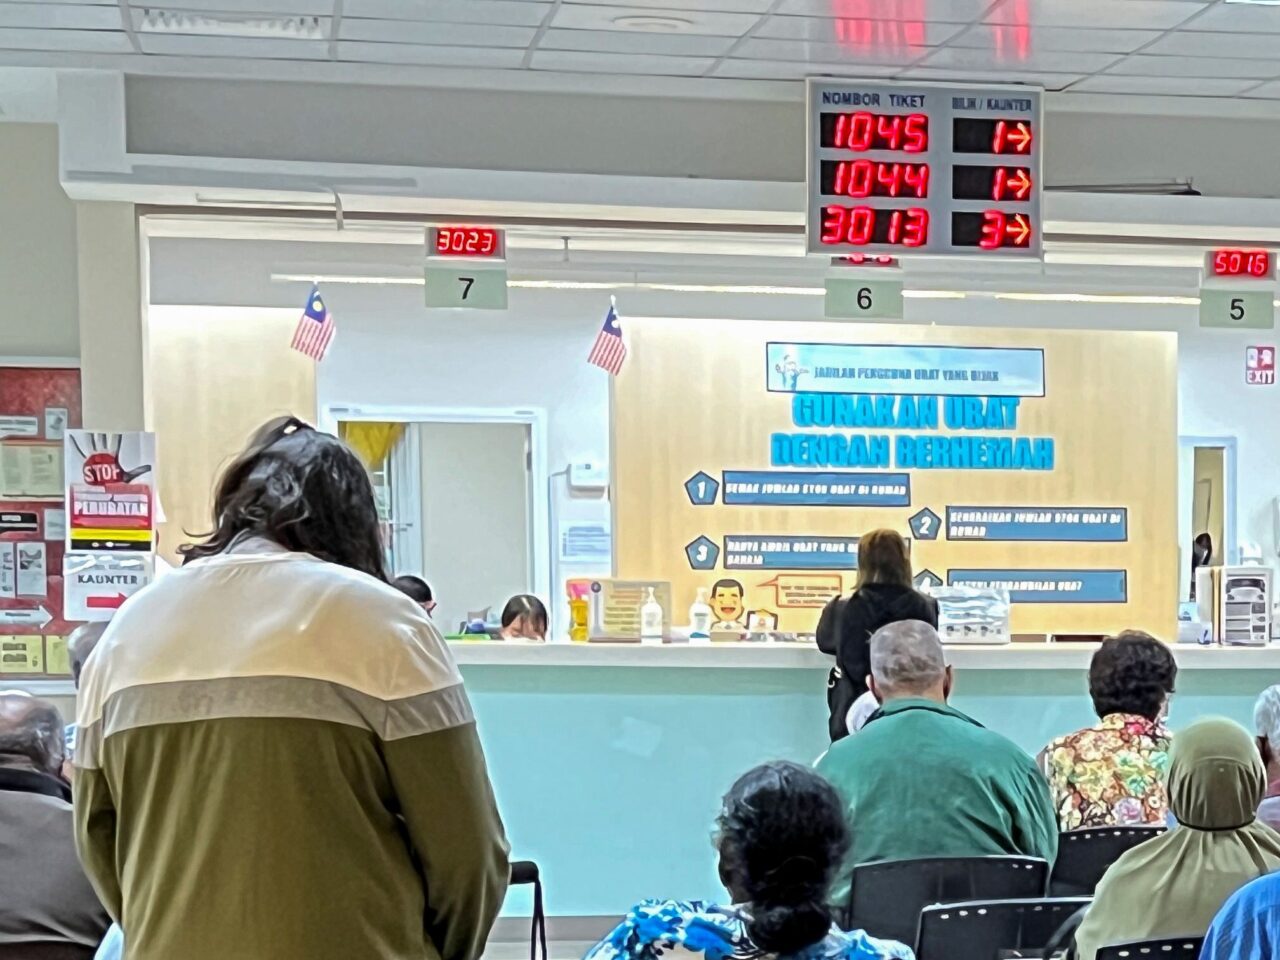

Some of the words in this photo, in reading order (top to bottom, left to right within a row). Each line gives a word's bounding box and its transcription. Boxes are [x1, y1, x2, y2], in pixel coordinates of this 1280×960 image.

[822, 91, 880, 106] NOMBOR
[889, 94, 925, 108] TIKET
[952, 97, 977, 110] BILIK
[986, 98, 1032, 112] KAUNTER
[833, 112, 926, 152] 1045
[991, 120, 1005, 154] 1
[833, 159, 928, 199] 1044
[991, 167, 1005, 201] 1
[821, 205, 928, 248] 3013
[979, 210, 1005, 249] 3
[438, 230, 493, 252] 3023
[1215, 252, 1266, 274] 5016
[458, 277, 475, 300] 7
[857, 287, 872, 310] 6
[1229, 298, 1245, 320] 5
[1246, 369, 1274, 384] EXIT
[792, 393, 938, 429] GUNAKAN
[943, 395, 1020, 430] UBAT
[771, 432, 890, 468] DENGAN
[895, 434, 1055, 470] BERHEMAH
[84, 463, 120, 483] STOP
[696, 481, 706, 499] 1
[919, 516, 932, 535] 2
[696, 545, 708, 562] 3
[77, 574, 138, 585] KAUNTER
